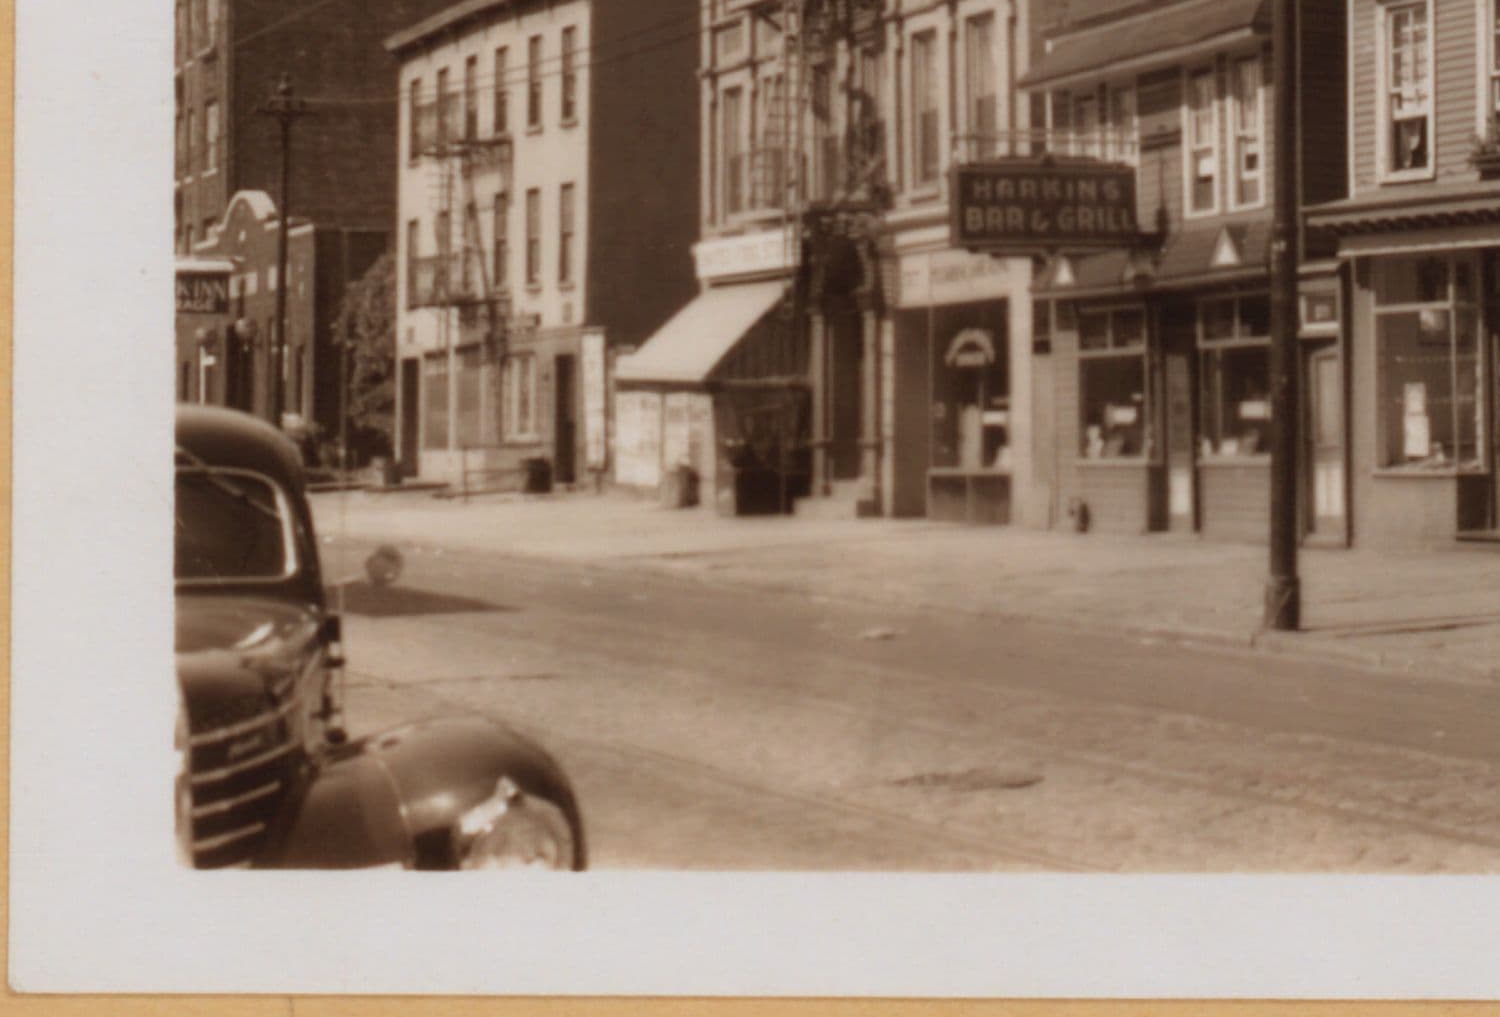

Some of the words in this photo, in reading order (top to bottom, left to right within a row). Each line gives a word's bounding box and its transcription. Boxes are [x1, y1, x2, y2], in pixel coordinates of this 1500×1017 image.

[973, 177, 1120, 201] HARKINS
[965, 205, 1026, 232] BAR
[1030, 205, 1051, 232] &
[1056, 204, 1133, 232] GRILL
